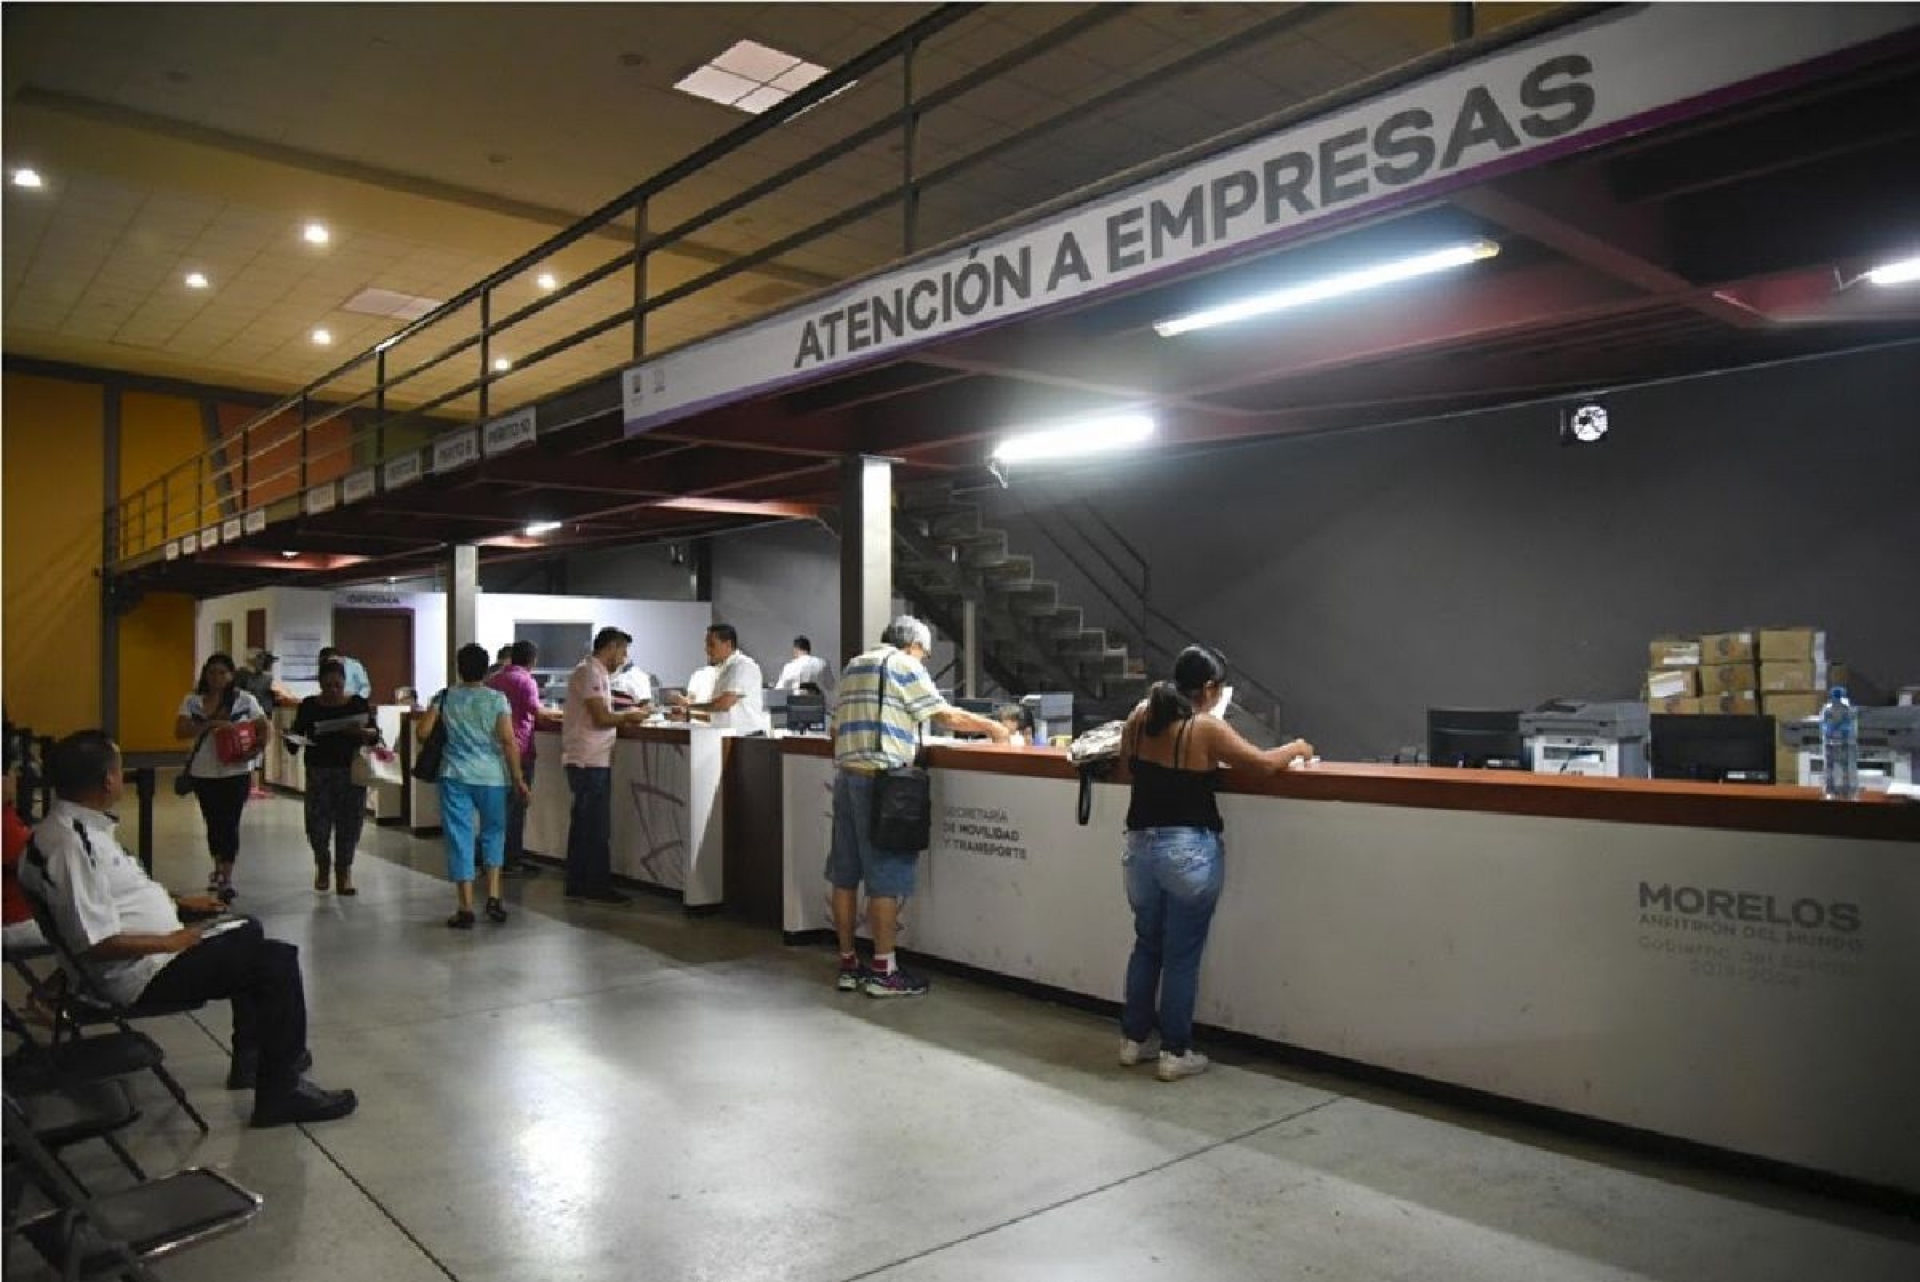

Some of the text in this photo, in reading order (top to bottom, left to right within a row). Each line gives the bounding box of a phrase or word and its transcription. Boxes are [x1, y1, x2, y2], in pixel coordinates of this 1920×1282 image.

[794, 55, 1596, 369] ATENCIÓN A EMPRESAS
[953, 839, 1027, 860] TRANSPORTE
[960, 824, 1020, 842] MOVILIDAD
[1638, 881, 1862, 933] MORELOS
